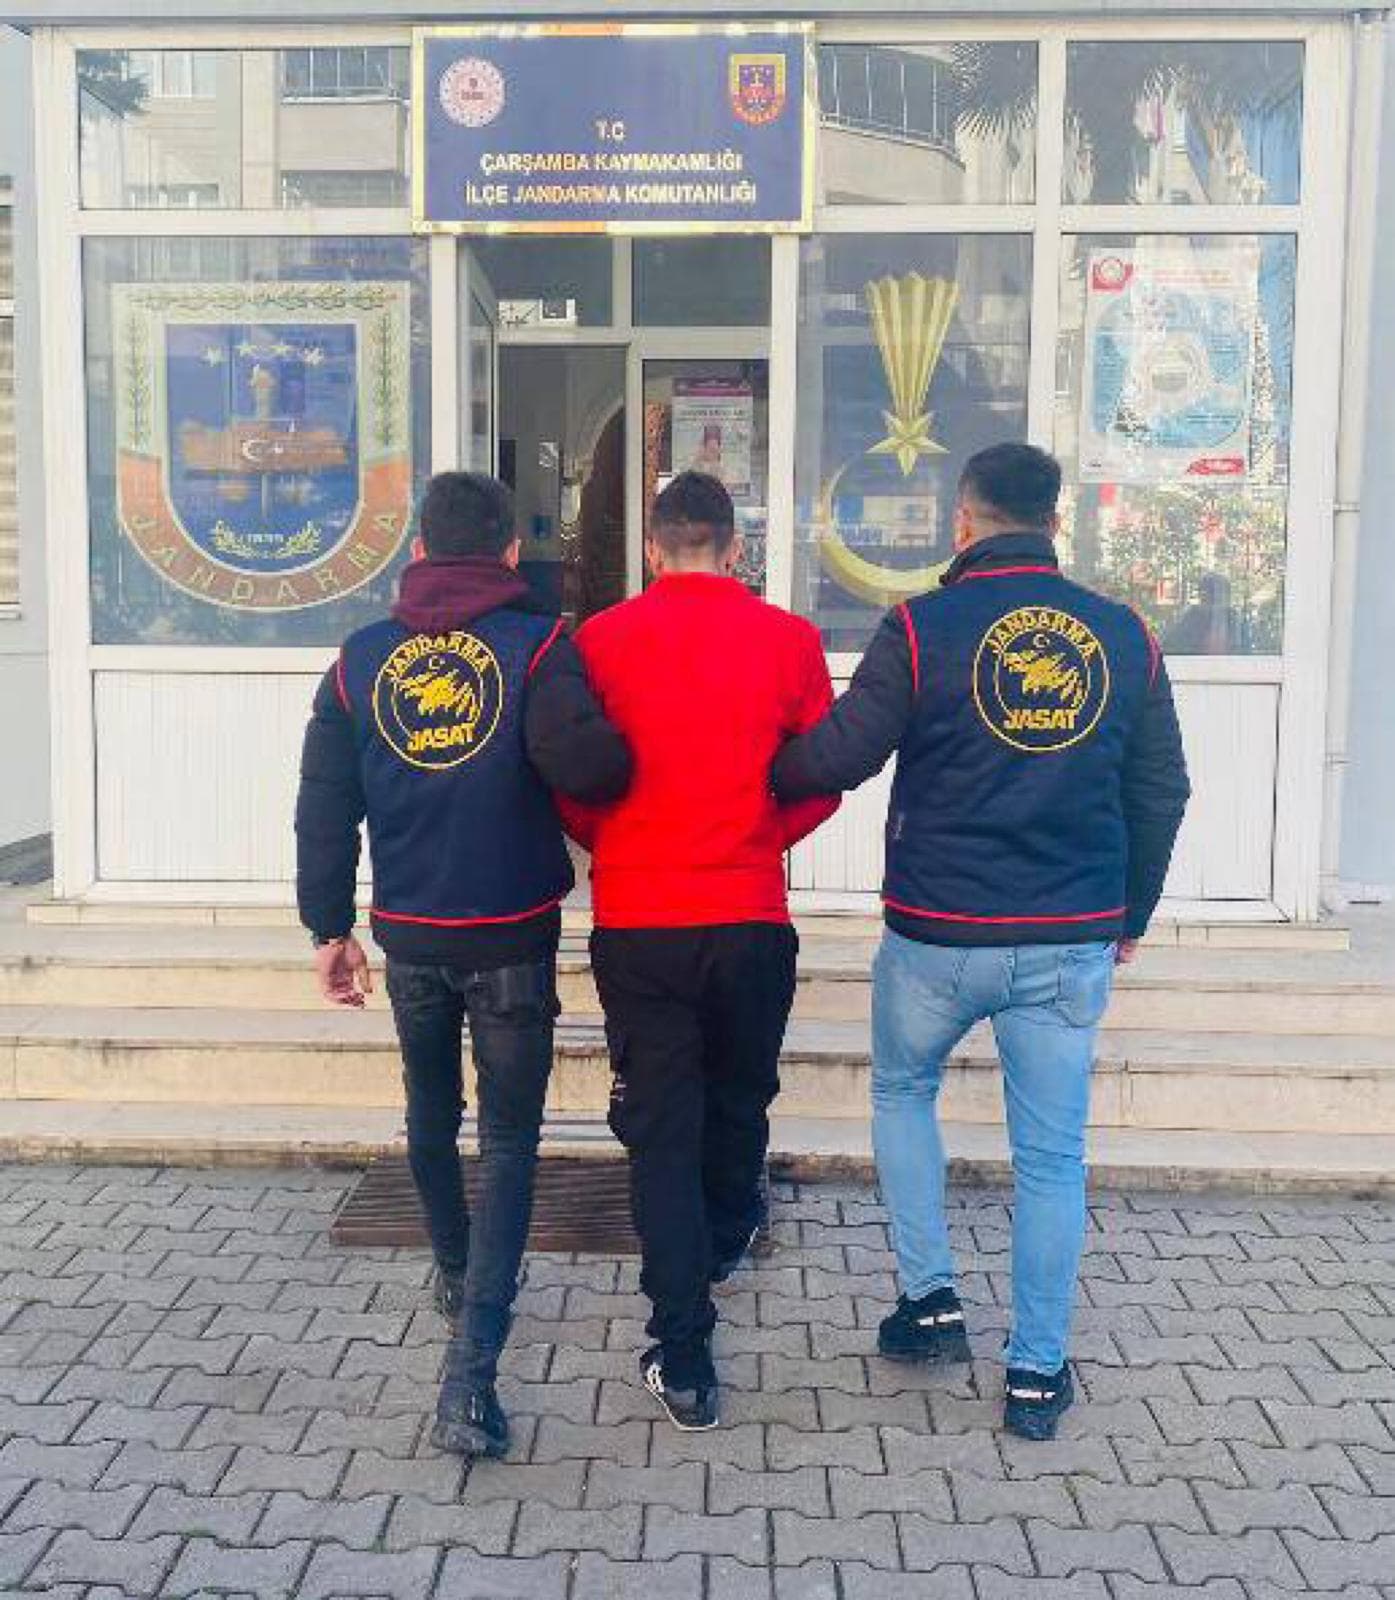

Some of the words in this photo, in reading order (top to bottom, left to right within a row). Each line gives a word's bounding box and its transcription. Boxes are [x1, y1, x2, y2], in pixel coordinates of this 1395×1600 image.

[480, 153, 589, 176] ÇARŞAMBA
[595, 148, 743, 171] KAYMAKAMLIĞI
[465, 180, 508, 206] İLÇE
[513, 185, 621, 204] JANDARMA
[625, 180, 756, 204] KOMUTANLIĞI
[129, 512, 398, 602] JANDARMA
[986, 610, 1099, 665] JANDARMA
[386, 634, 490, 683] JANDARMA
[1003, 709, 1078, 729] JASAT
[407, 722, 475, 751] JASAT
